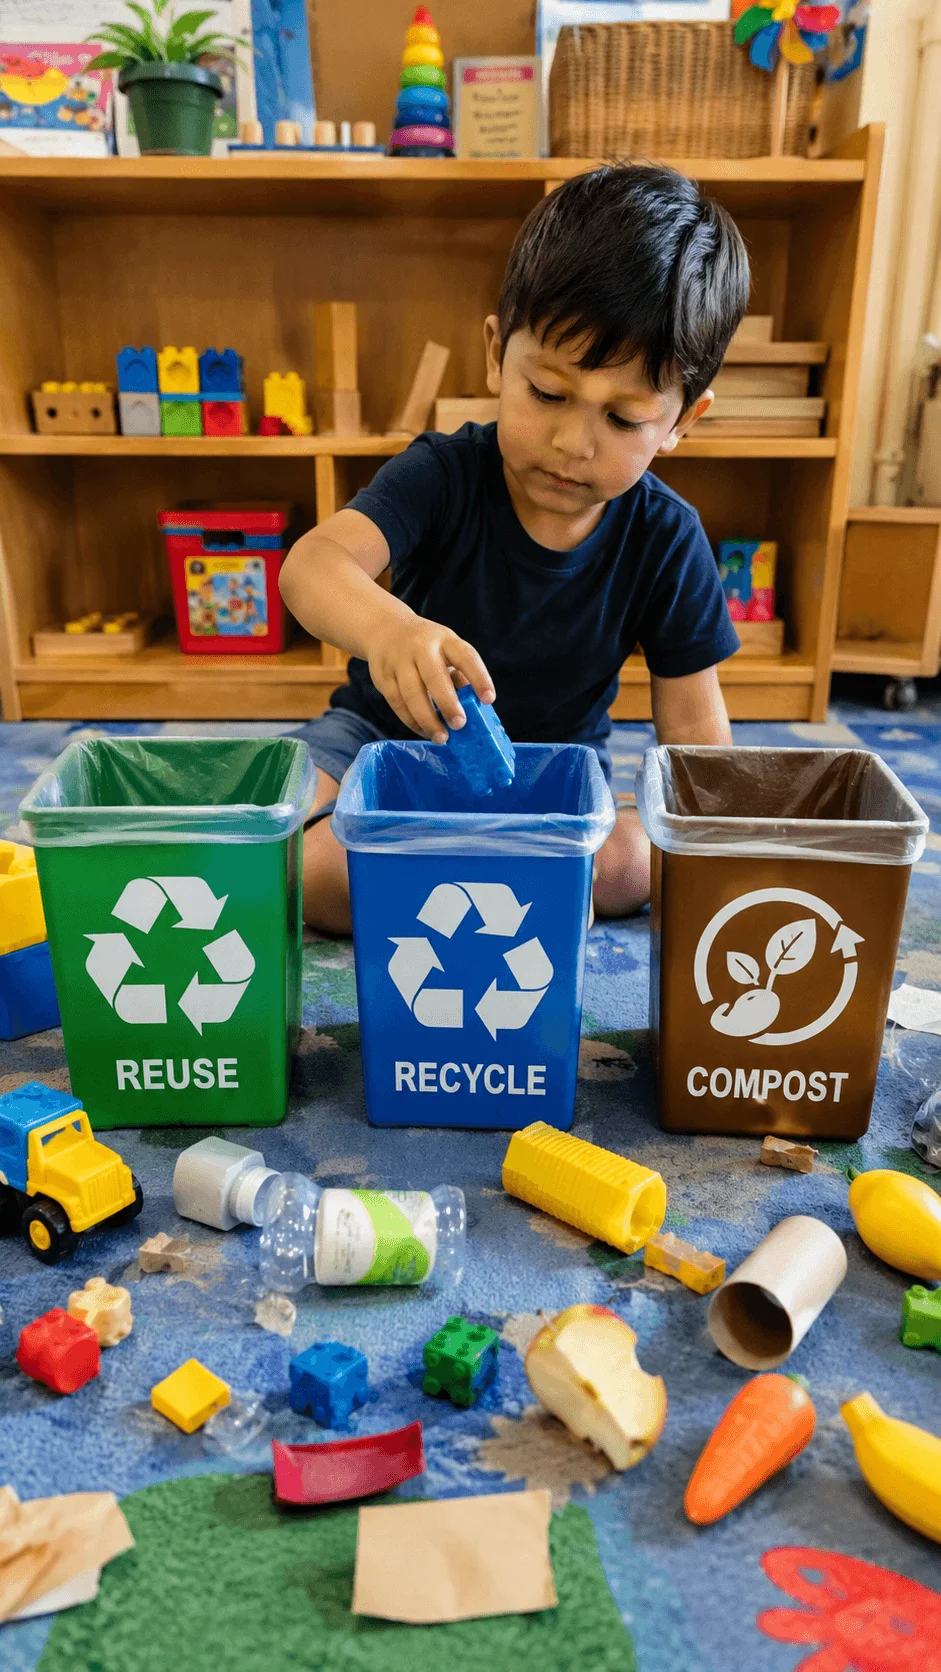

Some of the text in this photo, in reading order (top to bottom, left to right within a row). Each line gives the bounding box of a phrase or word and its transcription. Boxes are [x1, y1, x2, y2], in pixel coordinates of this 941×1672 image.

[115, 1057, 240, 1091] REUSE
[394, 1061, 547, 1096] RECYCLE
[686, 1066, 850, 1103] COMPOST
